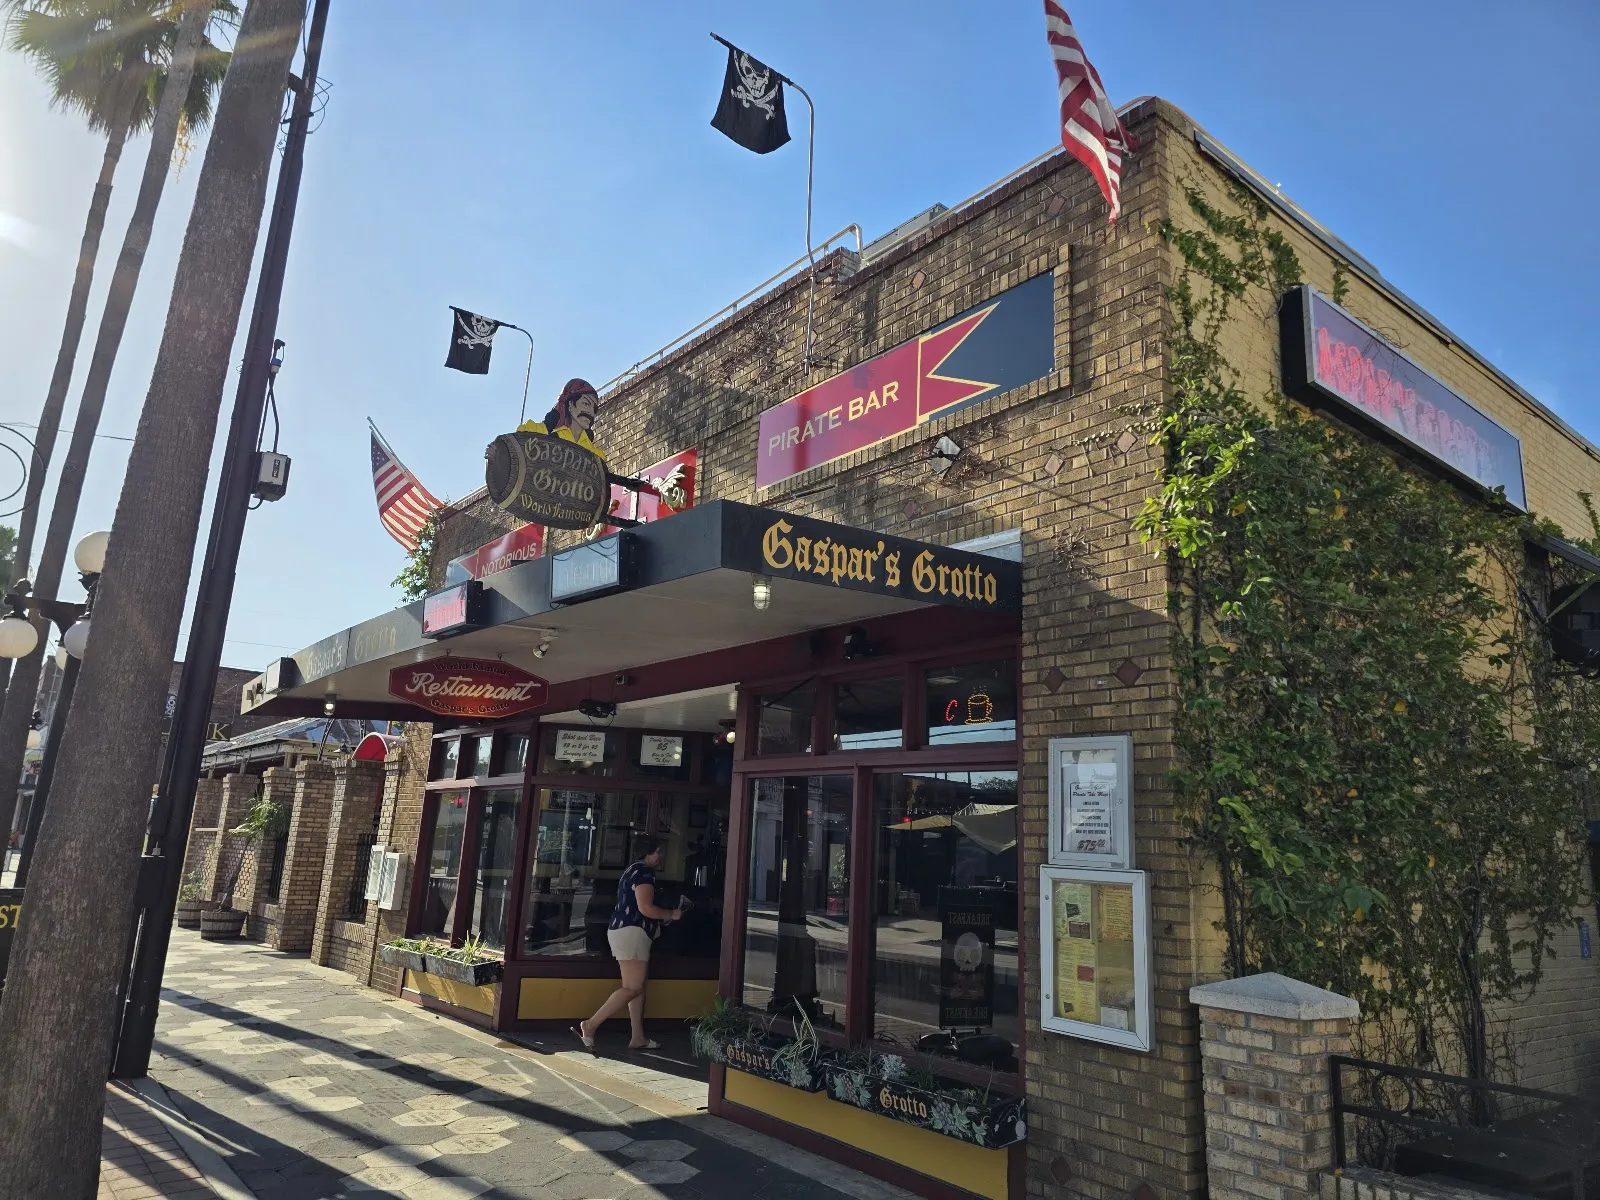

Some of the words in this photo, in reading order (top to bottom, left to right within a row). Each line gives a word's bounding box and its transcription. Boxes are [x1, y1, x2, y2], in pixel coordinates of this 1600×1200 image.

[768, 405, 843, 457] PIRATE
[848, 381, 899, 422] BAR
[533, 467, 595, 501] Grotto
[520, 493, 551, 516] World
[552, 503, 592, 522] Famous
[481, 543, 537, 578] NOTORIOUS
[762, 518, 901, 587] Gaspar's
[911, 549, 997, 605] Grotto
[433, 662, 469, 672] World
[405, 671, 541, 701] Restaurant
[430, 699, 475, 713] Gaspar's
[477, 702, 510, 713] Grotto
[726, 1043, 770, 1070] Gaspar's
[879, 1086, 928, 1118] Grotto
